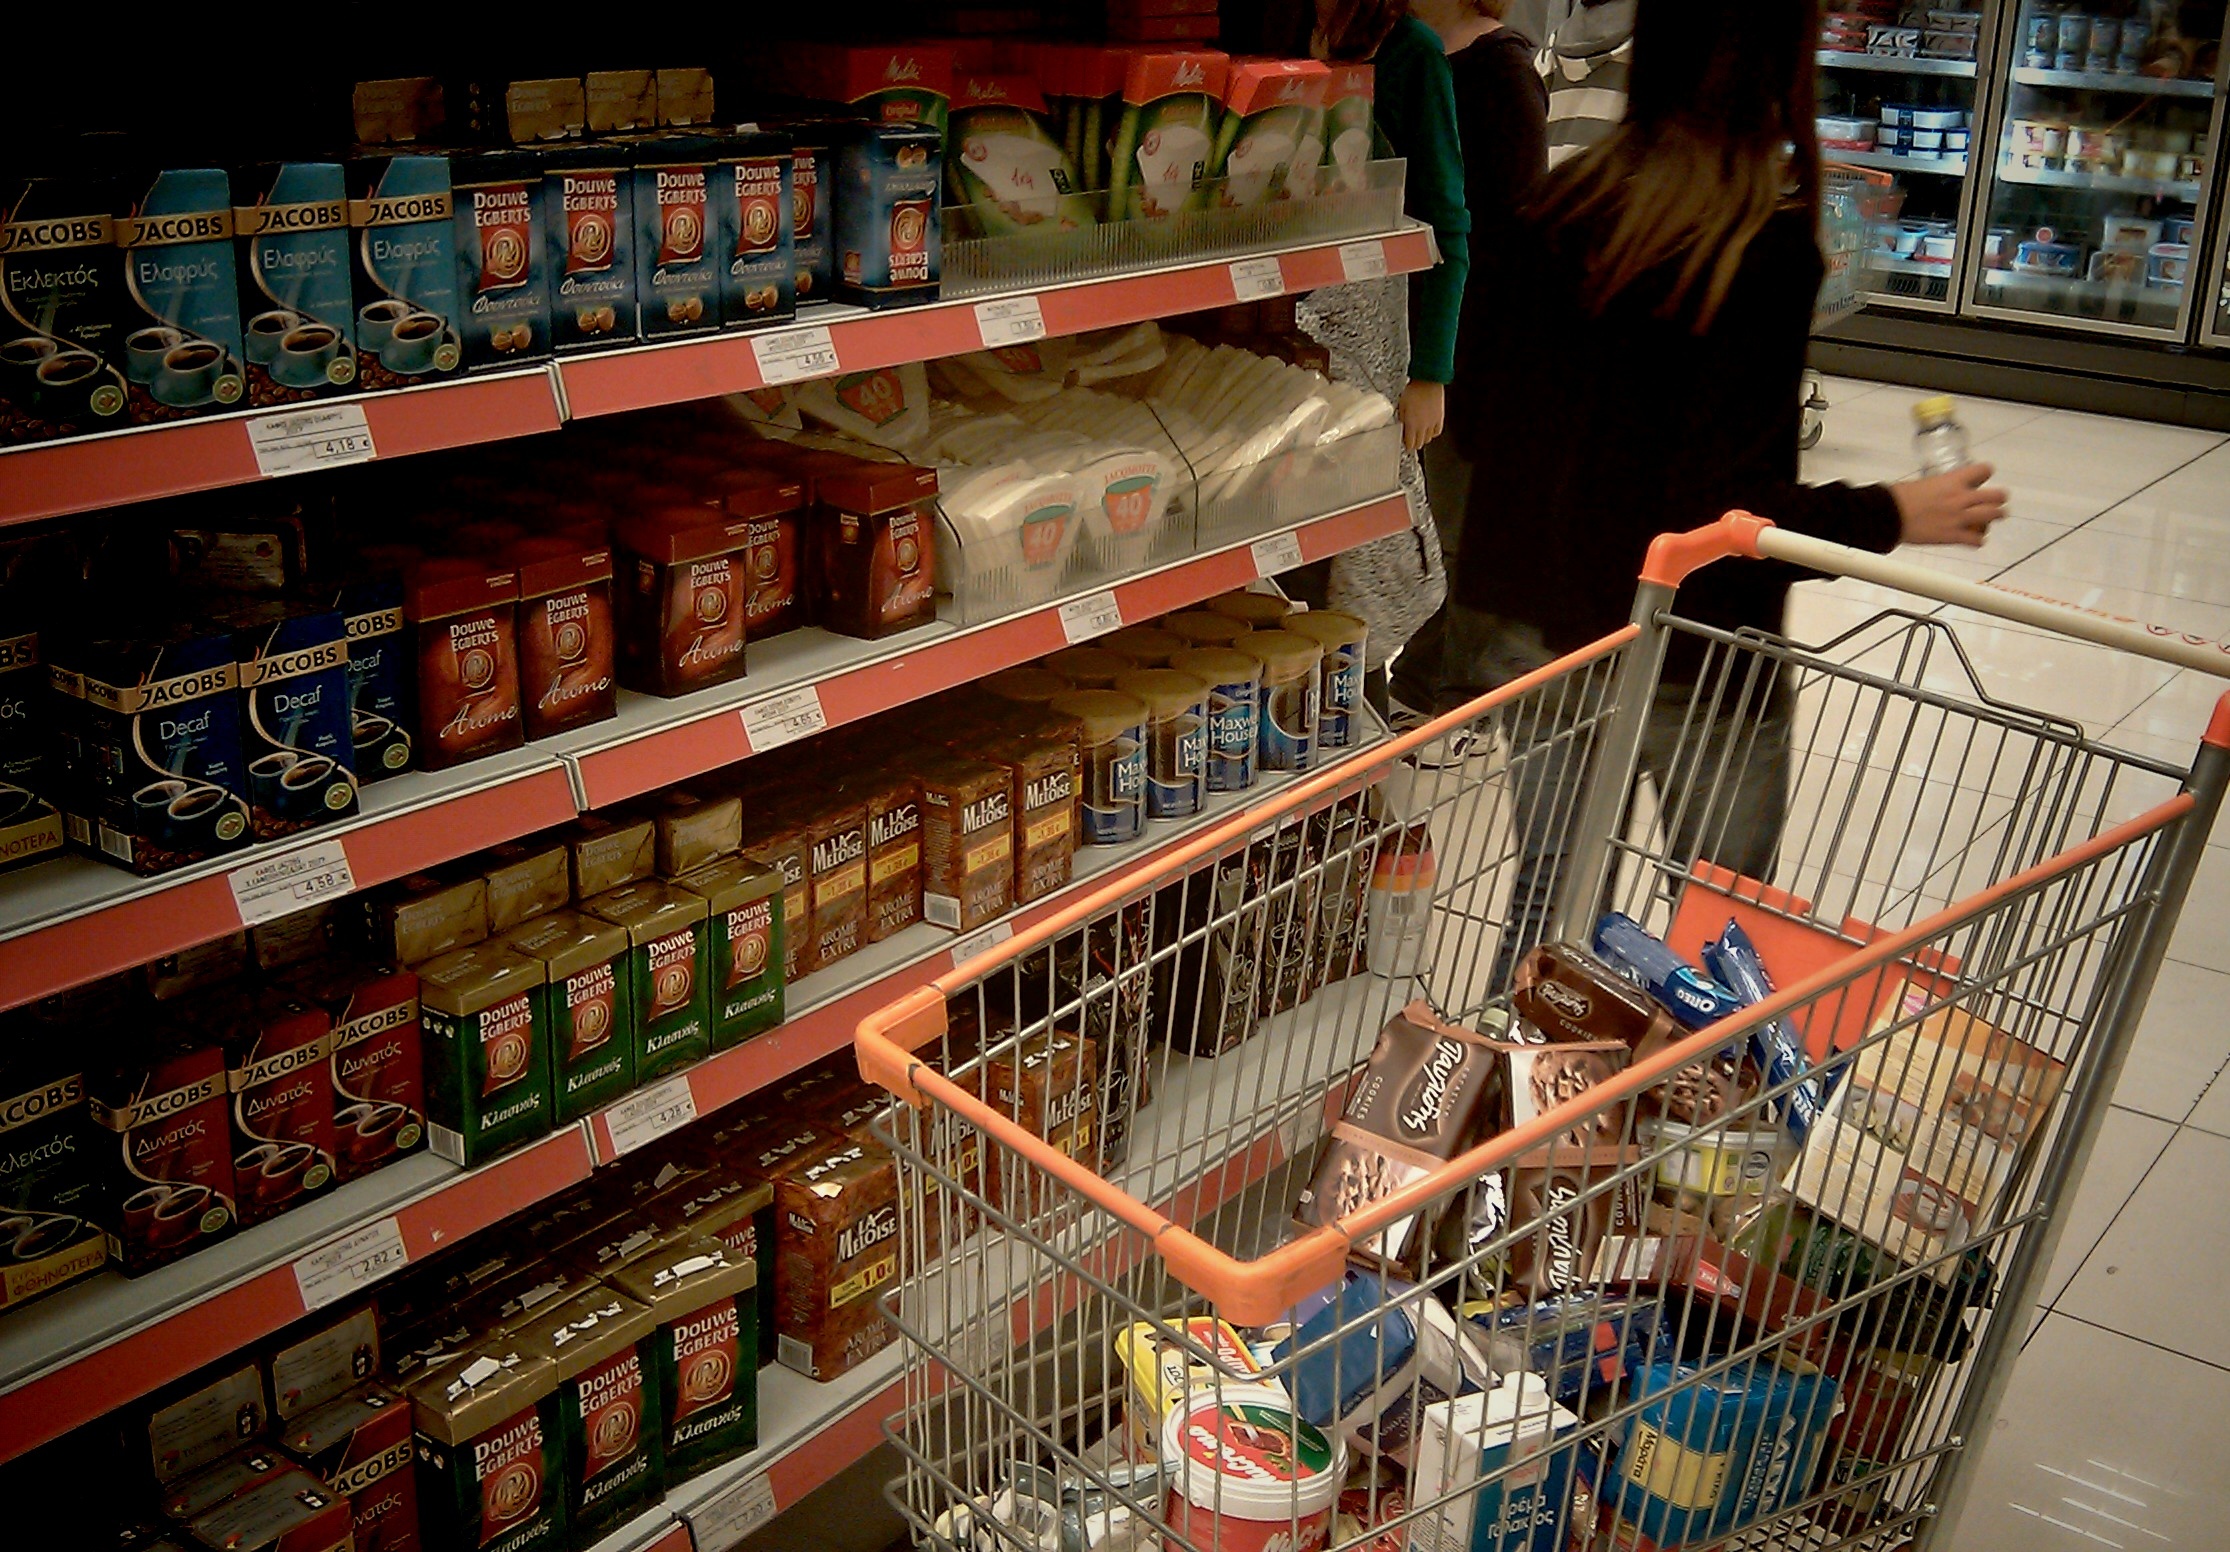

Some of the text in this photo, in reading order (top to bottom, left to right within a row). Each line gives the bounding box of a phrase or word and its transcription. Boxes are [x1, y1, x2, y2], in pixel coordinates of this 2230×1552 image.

[258, 205, 342, 232] JACOBS
[369, 197, 447, 224] JACOBS
[3, 219, 103, 249] JACOBS
[133, 215, 225, 243] JACOBS
[264, 247, 338, 272] Ελαφρύς
[373, 237, 442, 261] Ελαφρύς
[10, 264, 99, 292] Εκλεκτός
[139, 259, 219, 285] Ελαφρύς
[345, 612, 397, 637] COBS
[252, 647, 338, 685] JACOBS
[140, 670, 226, 709] JACOBS
[274, 685, 323, 714] Decaf
[160, 711, 212, 741] Decaf
[0, 830, 58, 857] ΝΟΤΕΡΑ
[1676, 987, 1717, 1013] OREO
[336, 1005, 409, 1048] JACOBS
[243, 1043, 320, 1087] JACOBS
[342, 1041, 402, 1077] Δυνατός
[0, 1080, 81, 1130] COBS
[129, 1081, 212, 1124] JACOBS
[247, 1082, 313, 1117] Δυνατός
[136, 1120, 206, 1157] Δυνατός
[13, 1250, 104, 1297] ΦΘΗΝΟΤΕΡΑ
[337, 1442, 410, 1492] ACOBS
